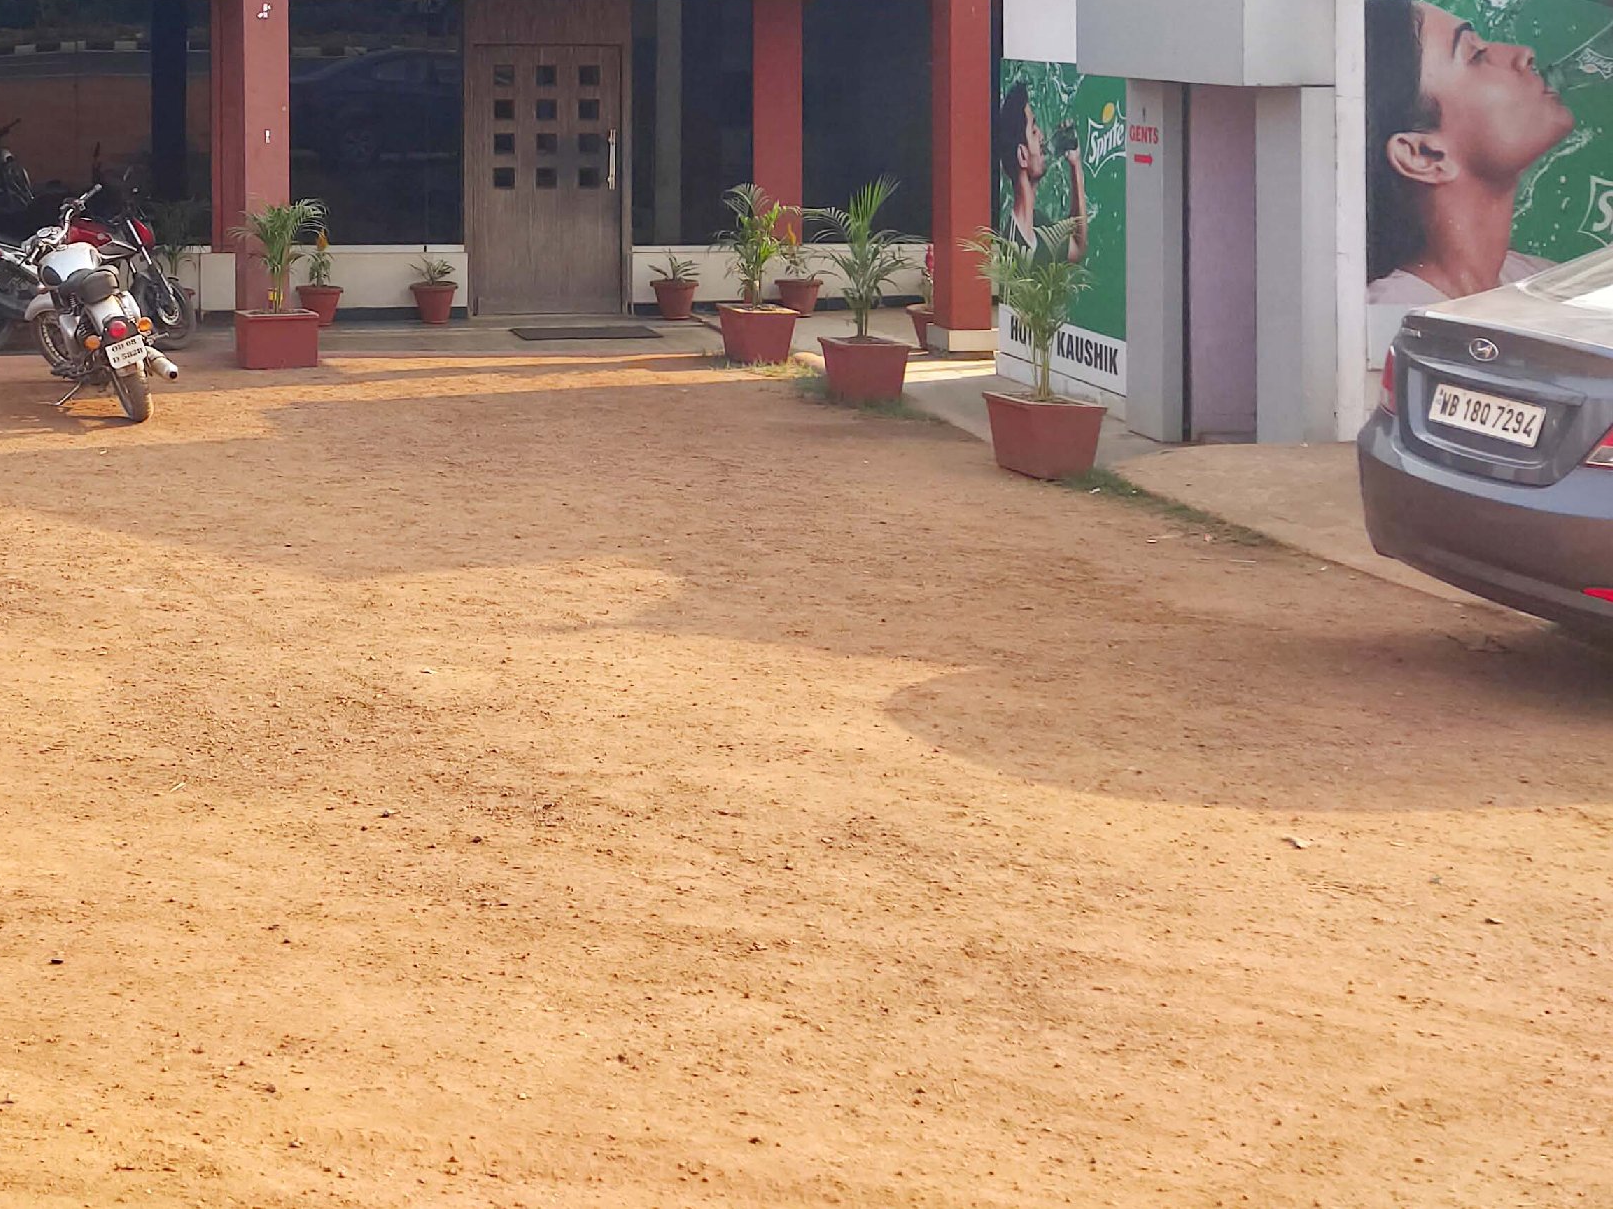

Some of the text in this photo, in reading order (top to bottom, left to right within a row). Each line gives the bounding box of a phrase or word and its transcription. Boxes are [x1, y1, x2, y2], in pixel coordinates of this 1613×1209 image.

[1088, 115, 1125, 167] Sprite
[1129, 124, 1159, 145] GENTS
[1056, 330, 1119, 376] KAUSHIK
[1491, 406, 1538, 438] 7294
